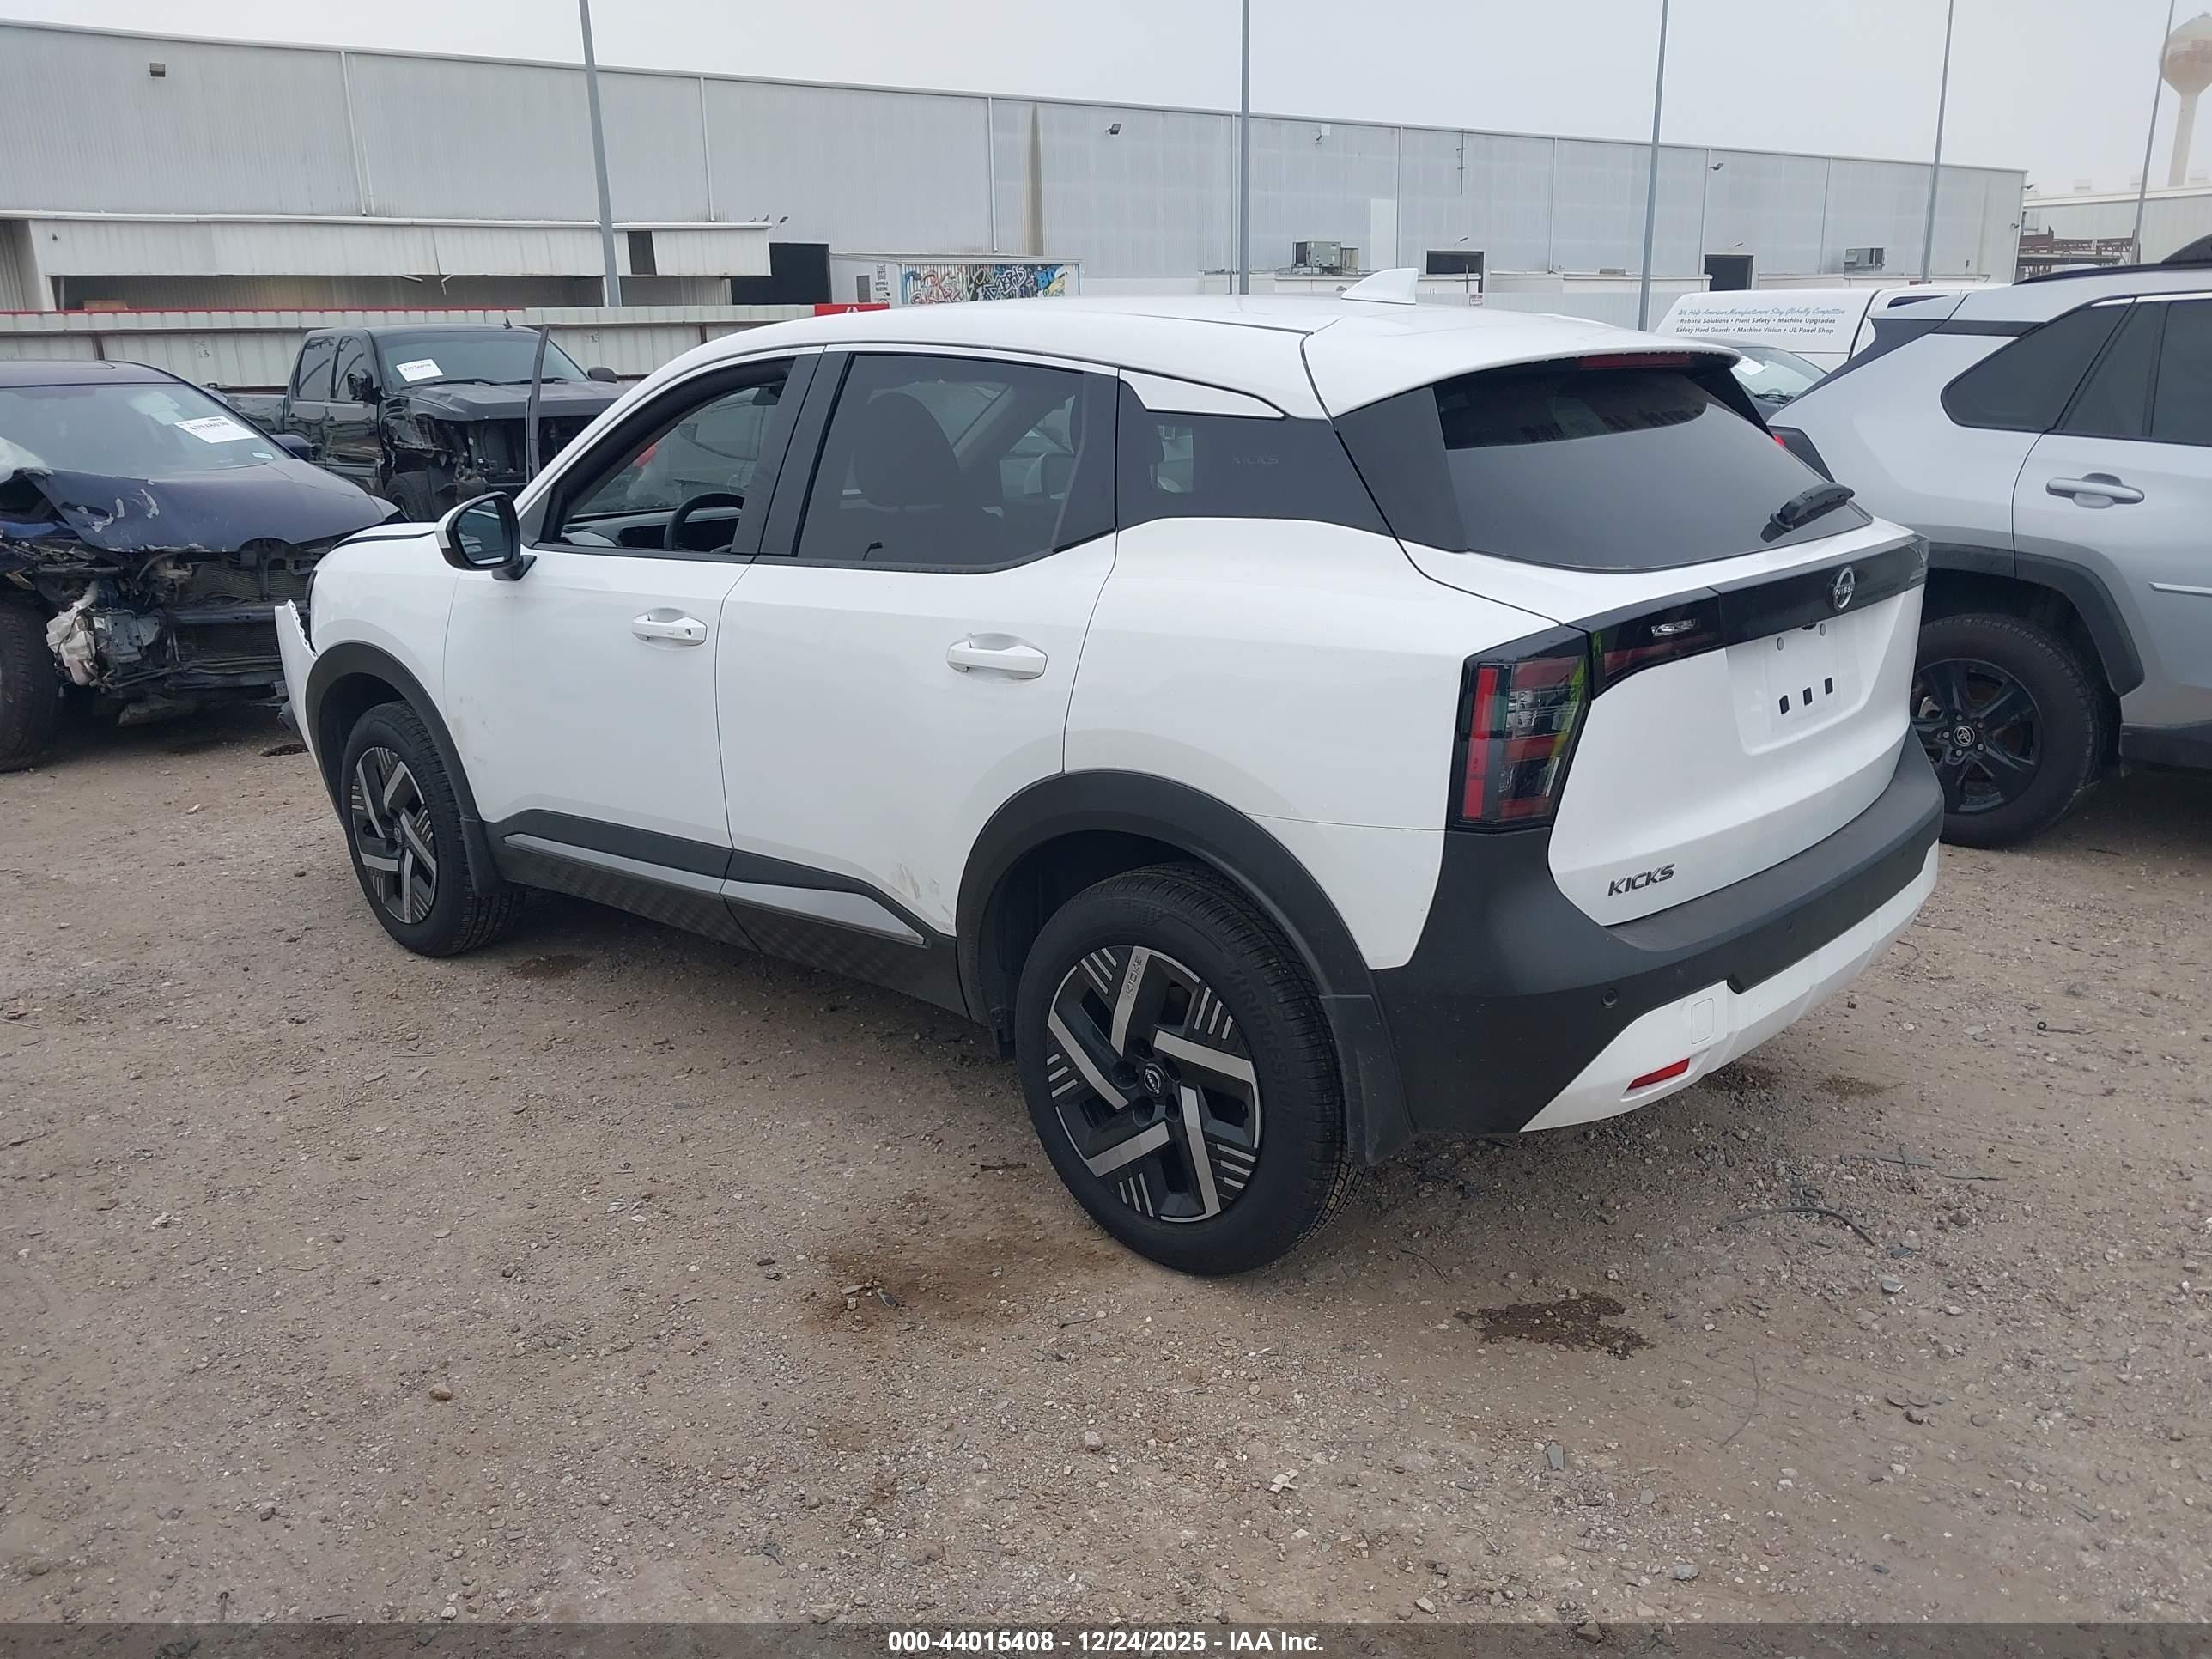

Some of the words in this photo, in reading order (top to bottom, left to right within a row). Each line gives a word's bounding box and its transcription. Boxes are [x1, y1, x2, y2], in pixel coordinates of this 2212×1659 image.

[1231, 453, 1279, 465] KICKS
[1607, 862, 1675, 896] KICKS
[1126, 955, 1143, 996] KICKS
